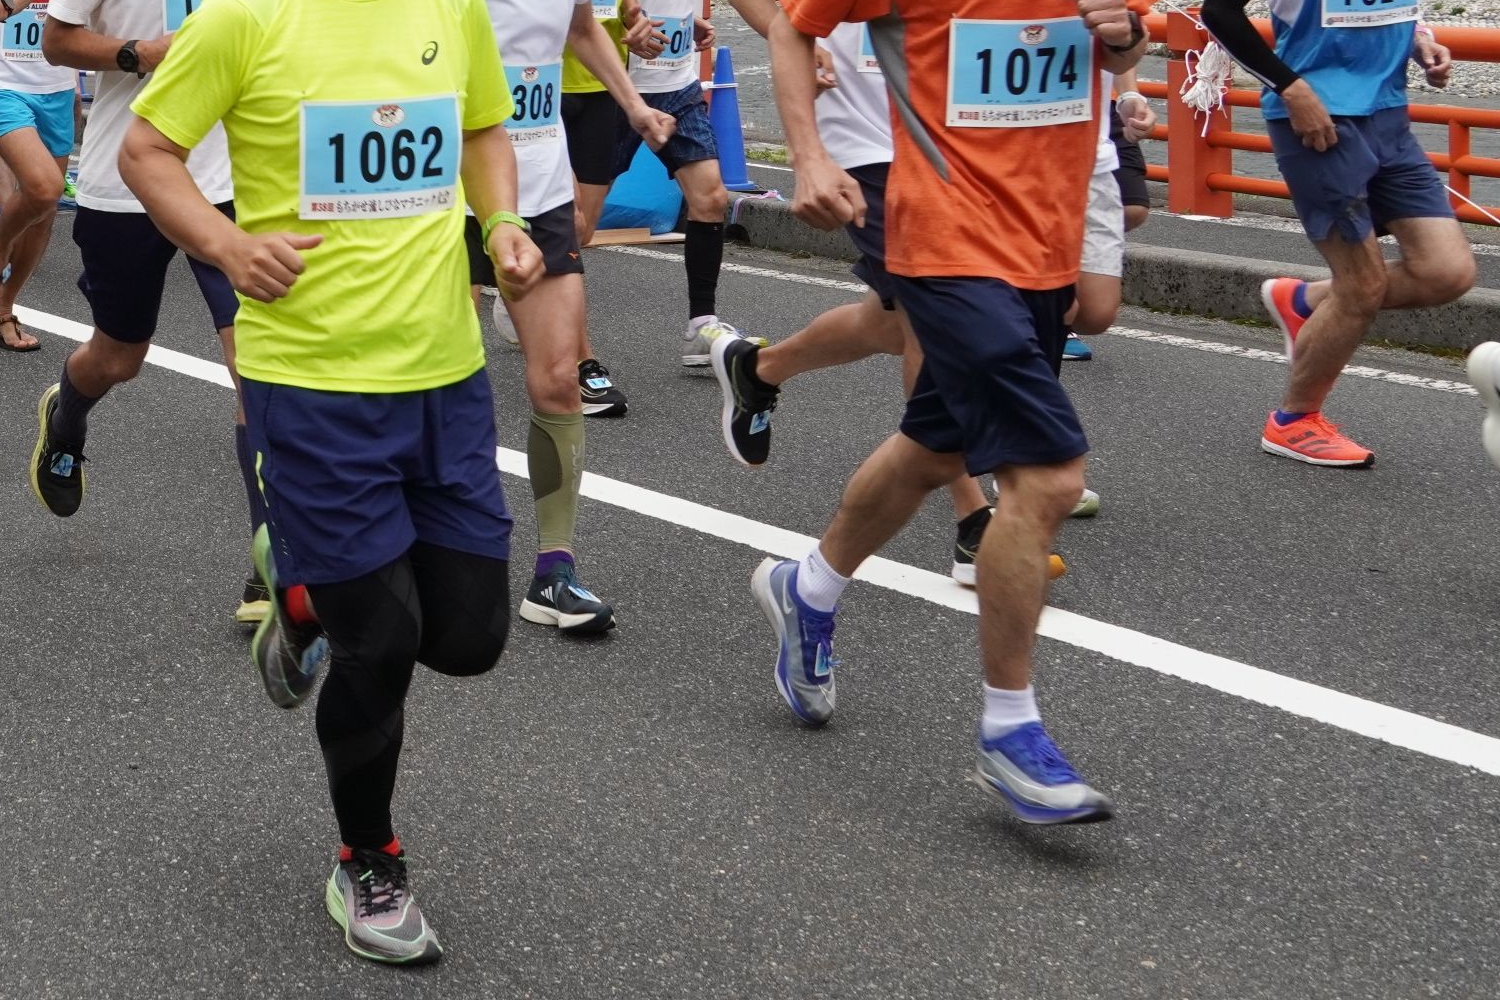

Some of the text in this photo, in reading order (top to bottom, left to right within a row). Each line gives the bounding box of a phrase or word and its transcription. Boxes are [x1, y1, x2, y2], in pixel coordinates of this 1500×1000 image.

[14, 22, 44, 46] 10
[976, 44, 1077, 96] 1074
[329, 126, 443, 184] 1062
